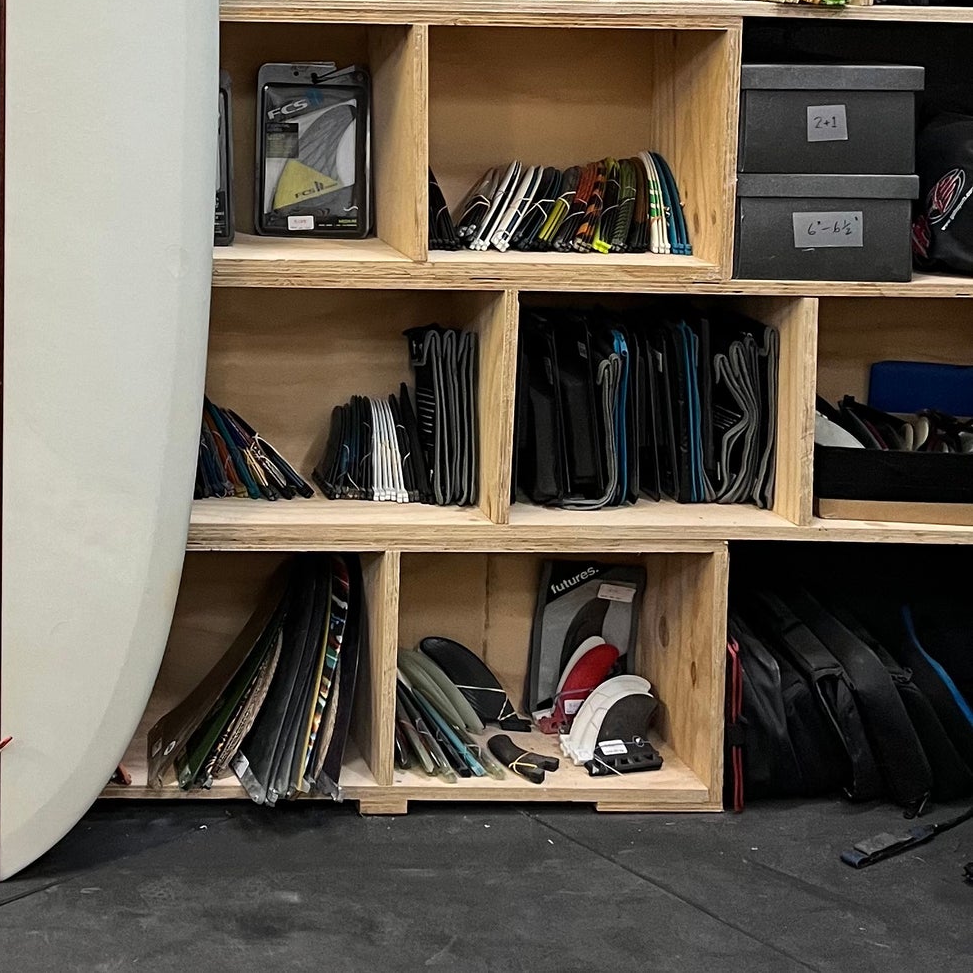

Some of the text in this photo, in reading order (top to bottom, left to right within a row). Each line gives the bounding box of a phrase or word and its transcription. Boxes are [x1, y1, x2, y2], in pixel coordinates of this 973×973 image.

[267, 99, 309, 120] FCS
[813, 116, 838, 129] 2+1
[551, 567, 600, 594] futures.
